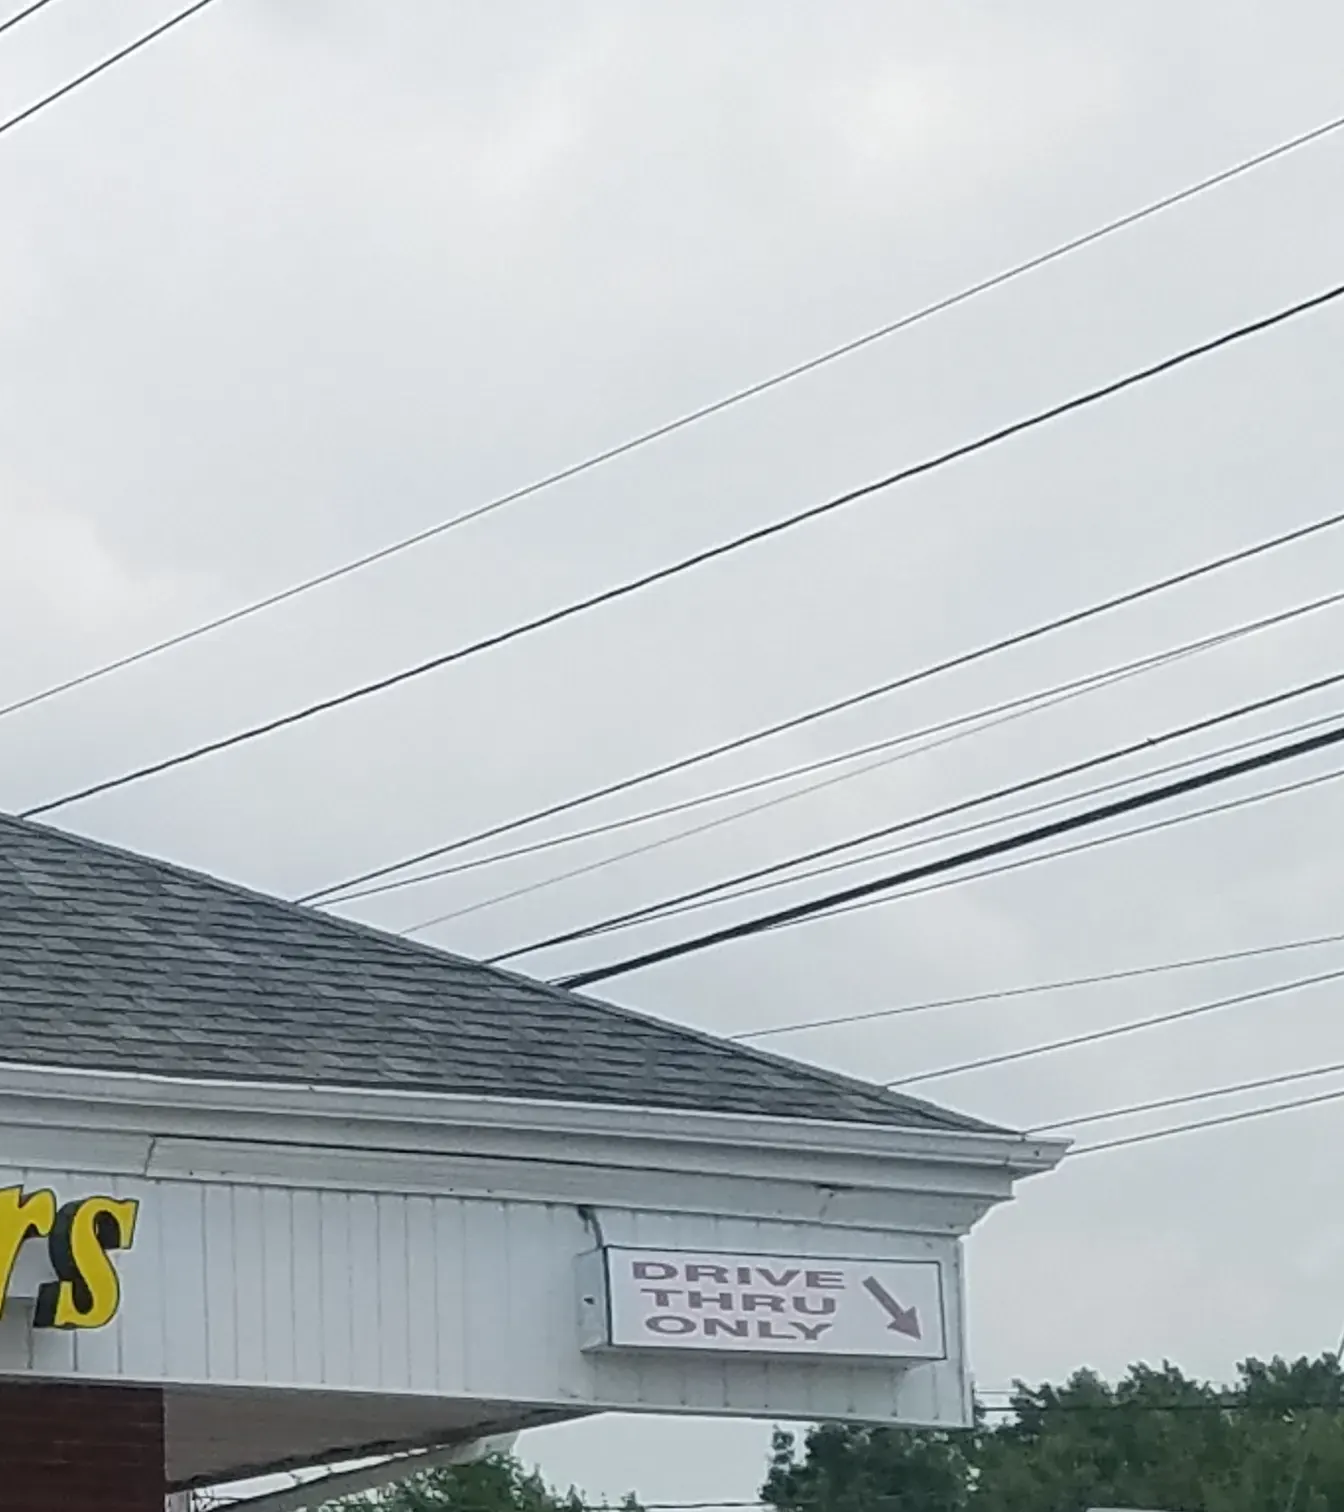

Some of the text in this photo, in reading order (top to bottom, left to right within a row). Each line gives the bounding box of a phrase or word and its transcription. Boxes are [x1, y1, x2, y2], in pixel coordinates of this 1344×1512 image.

[631, 1260, 847, 1290] DRIVE
[639, 1287, 836, 1316] THRU
[644, 1315, 834, 1341] ONLY
